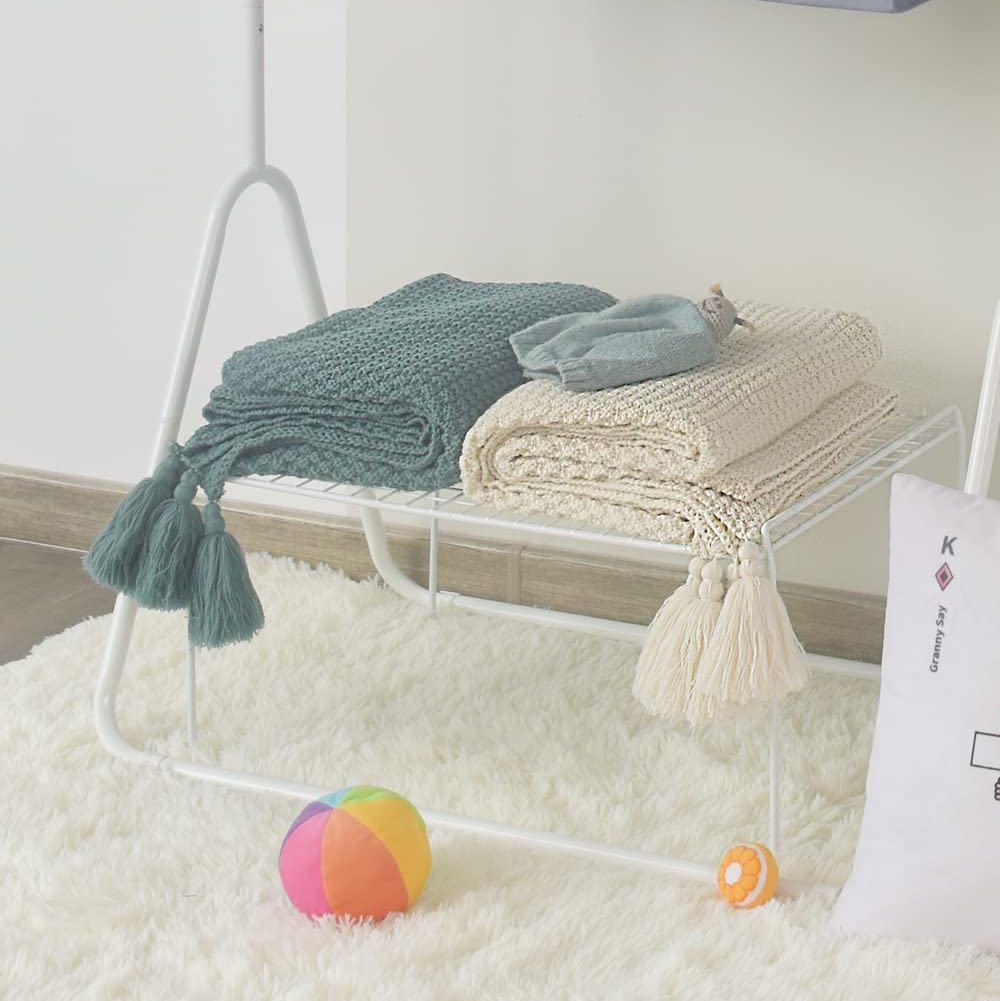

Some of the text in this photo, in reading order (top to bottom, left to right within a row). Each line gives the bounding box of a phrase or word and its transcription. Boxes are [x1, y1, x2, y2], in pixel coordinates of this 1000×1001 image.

[941, 535, 958, 556] K
[929, 604, 948, 673] Granny Say
